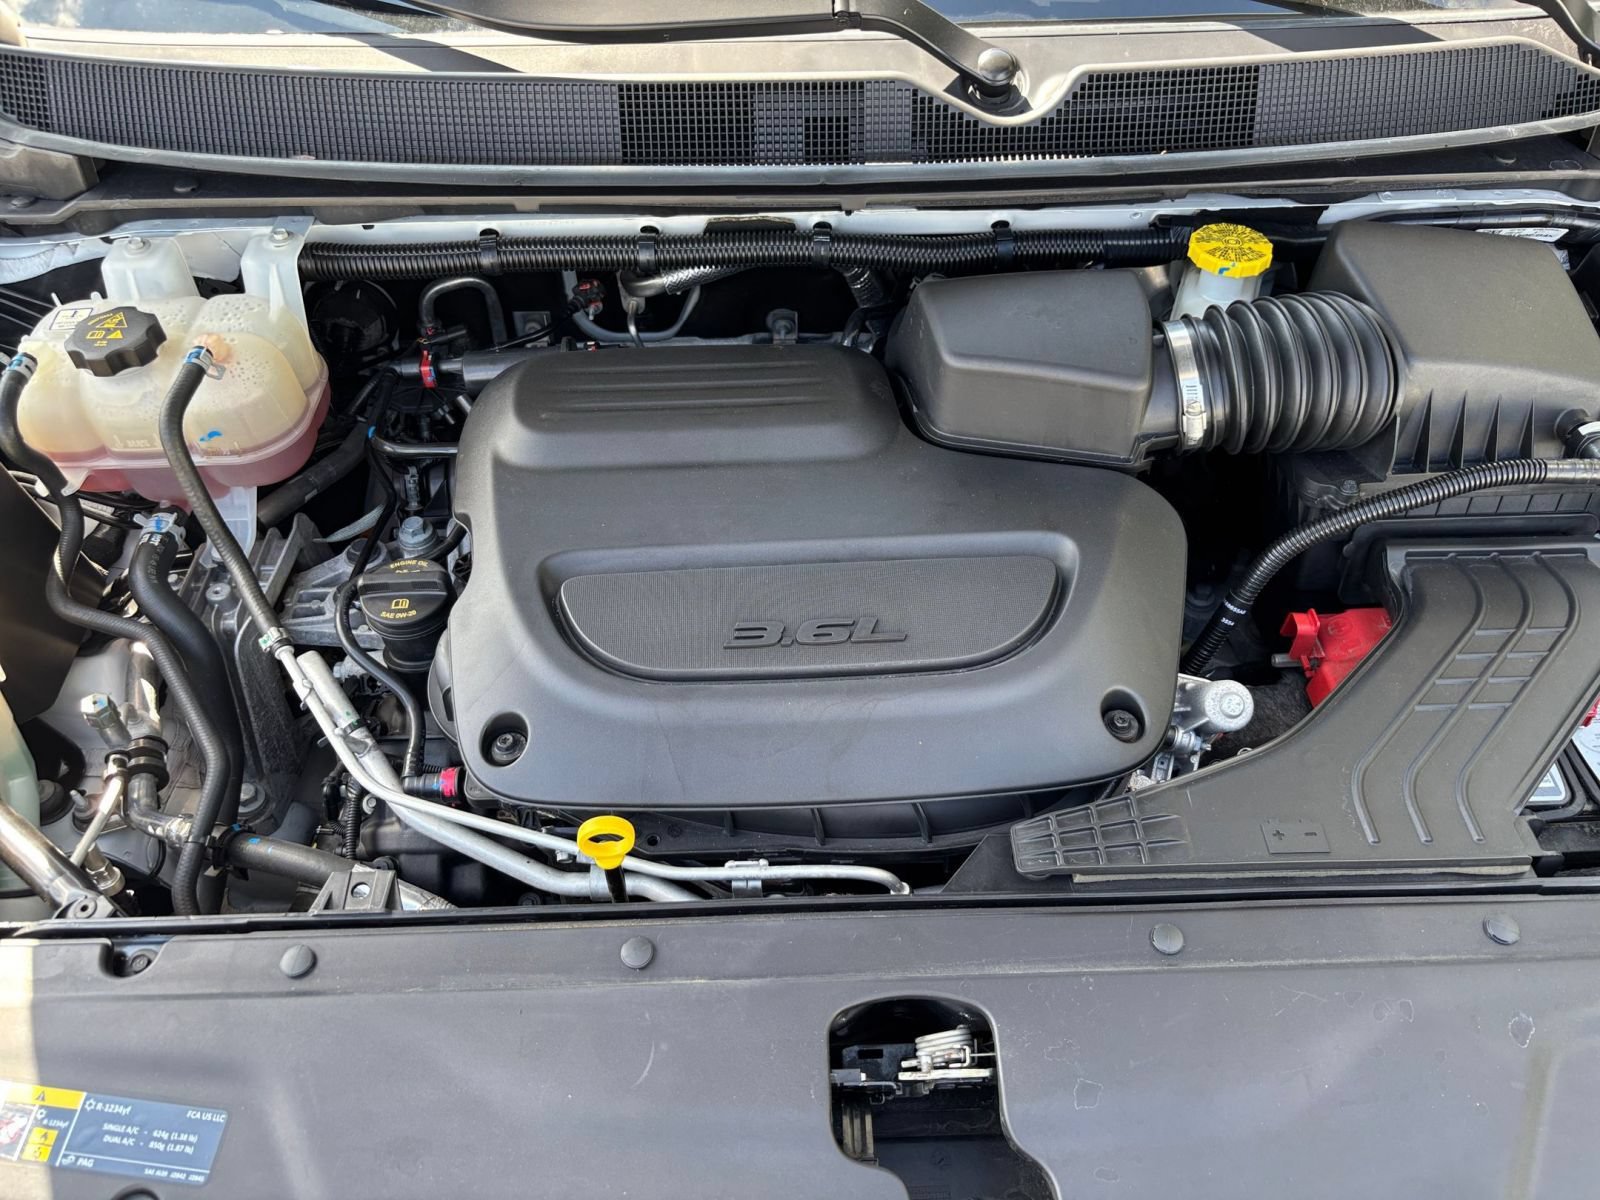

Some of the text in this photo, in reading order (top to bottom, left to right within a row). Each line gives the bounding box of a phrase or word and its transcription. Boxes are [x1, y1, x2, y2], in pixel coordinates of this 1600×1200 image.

[390, 560, 417, 569] ENGINE
[723, 616, 908, 649] 3.6L
[96, 1103, 131, 1116] R-1234yf
[186, 1110, 226, 1123] FCA US LLC
[77, 1158, 94, 1167] PAG
